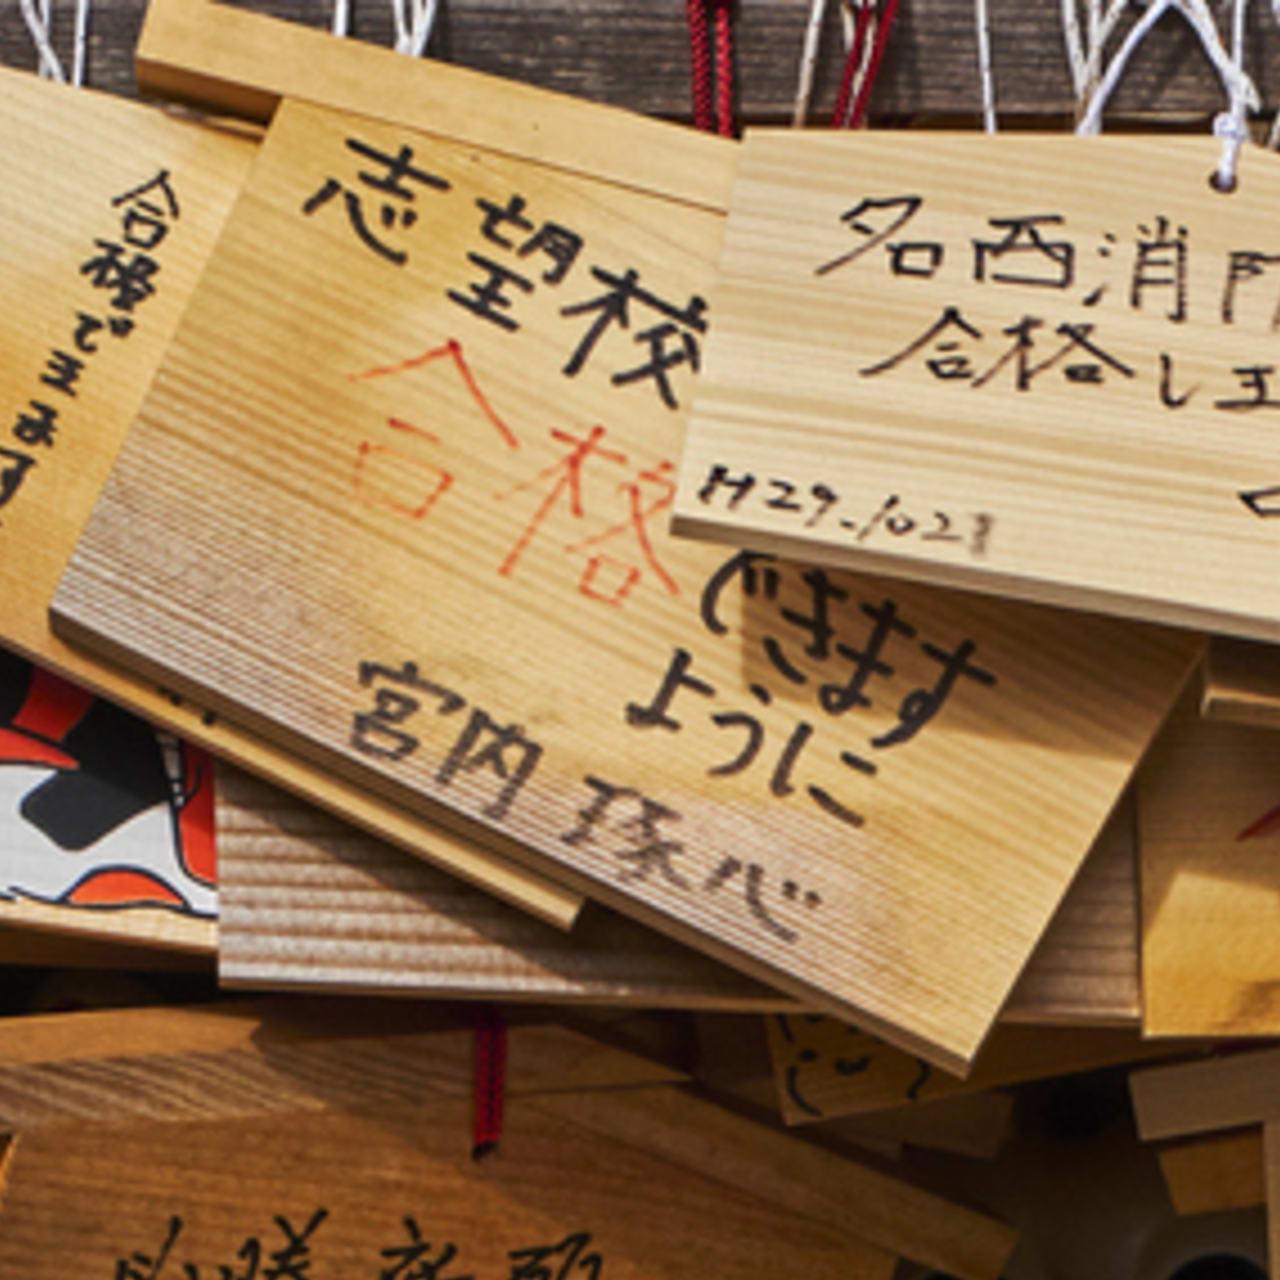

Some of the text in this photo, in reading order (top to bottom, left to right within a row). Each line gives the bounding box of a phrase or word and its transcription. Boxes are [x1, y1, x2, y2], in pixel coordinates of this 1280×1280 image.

[303, 136, 709, 411] 志望校
[348, 338, 681, 606] 合格
[624, 647, 865, 828] ように
